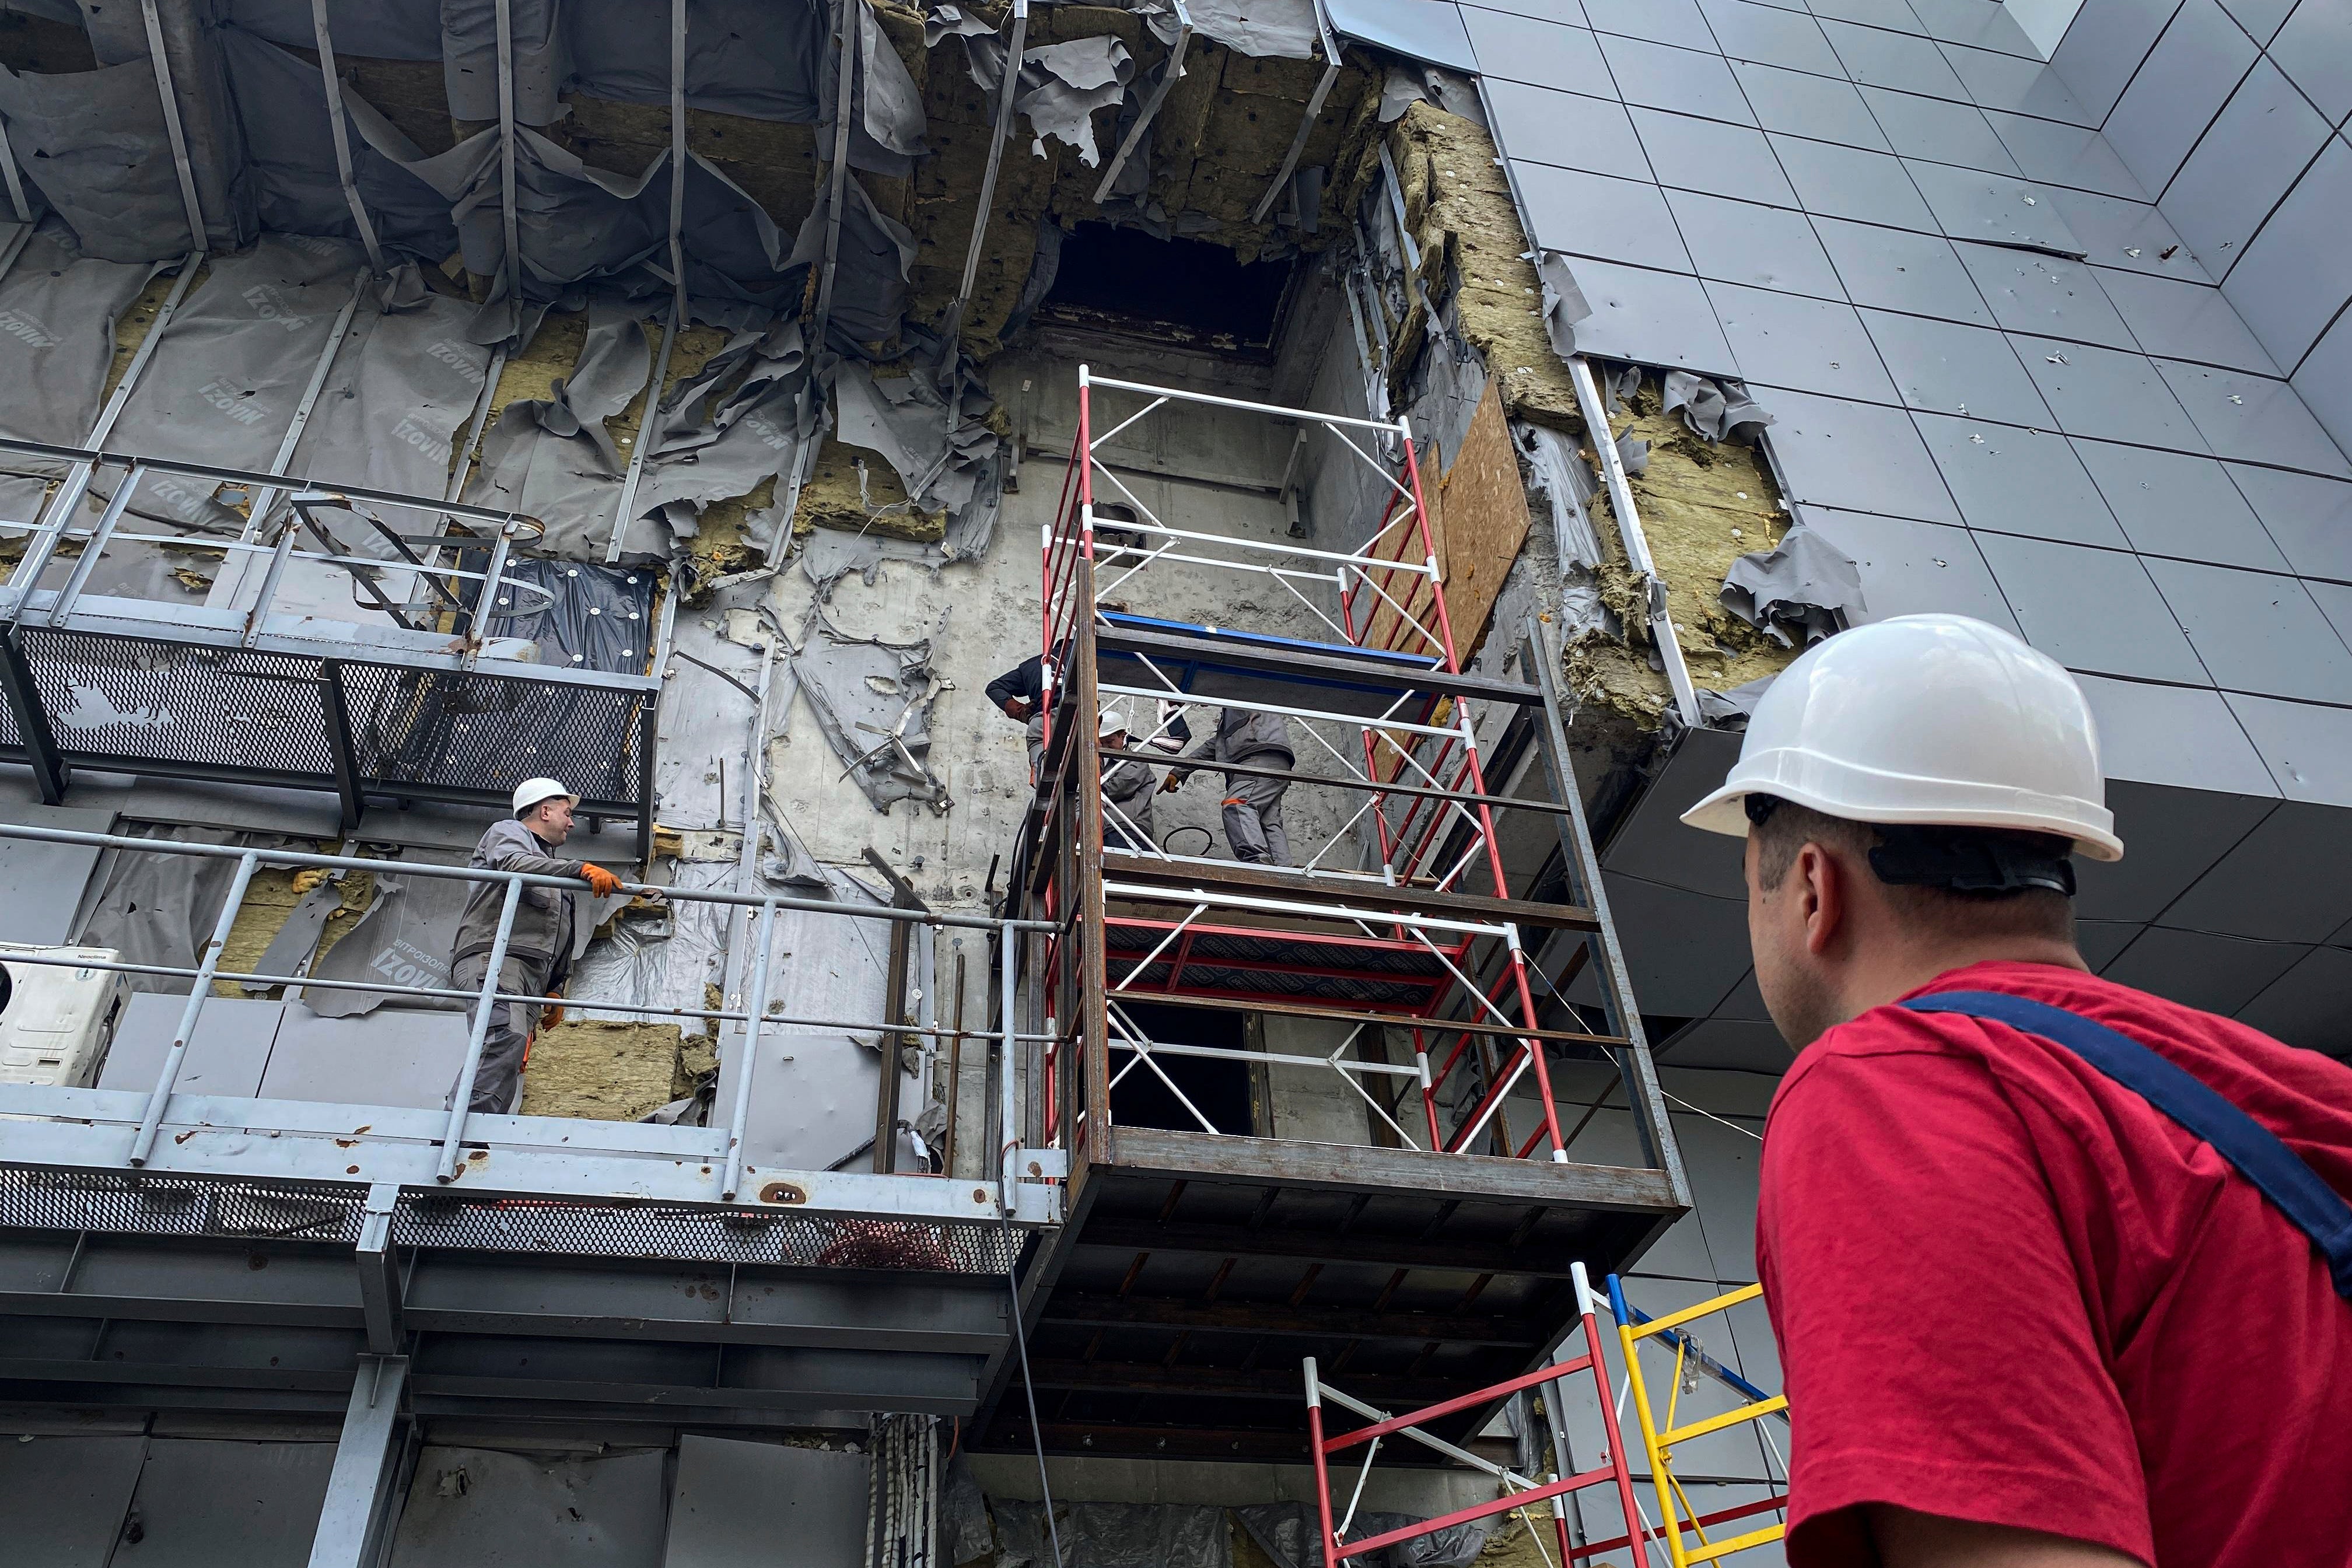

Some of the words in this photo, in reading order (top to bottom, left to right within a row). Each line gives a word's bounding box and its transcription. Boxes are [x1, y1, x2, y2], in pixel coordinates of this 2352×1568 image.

[426, 342, 485, 384] IZOVIN
[198, 382, 265, 425] IZOVIN
[391, 418, 449, 466] IZOVIN
[394, 939, 450, 974] ВІТРОІЗОЛЯ
